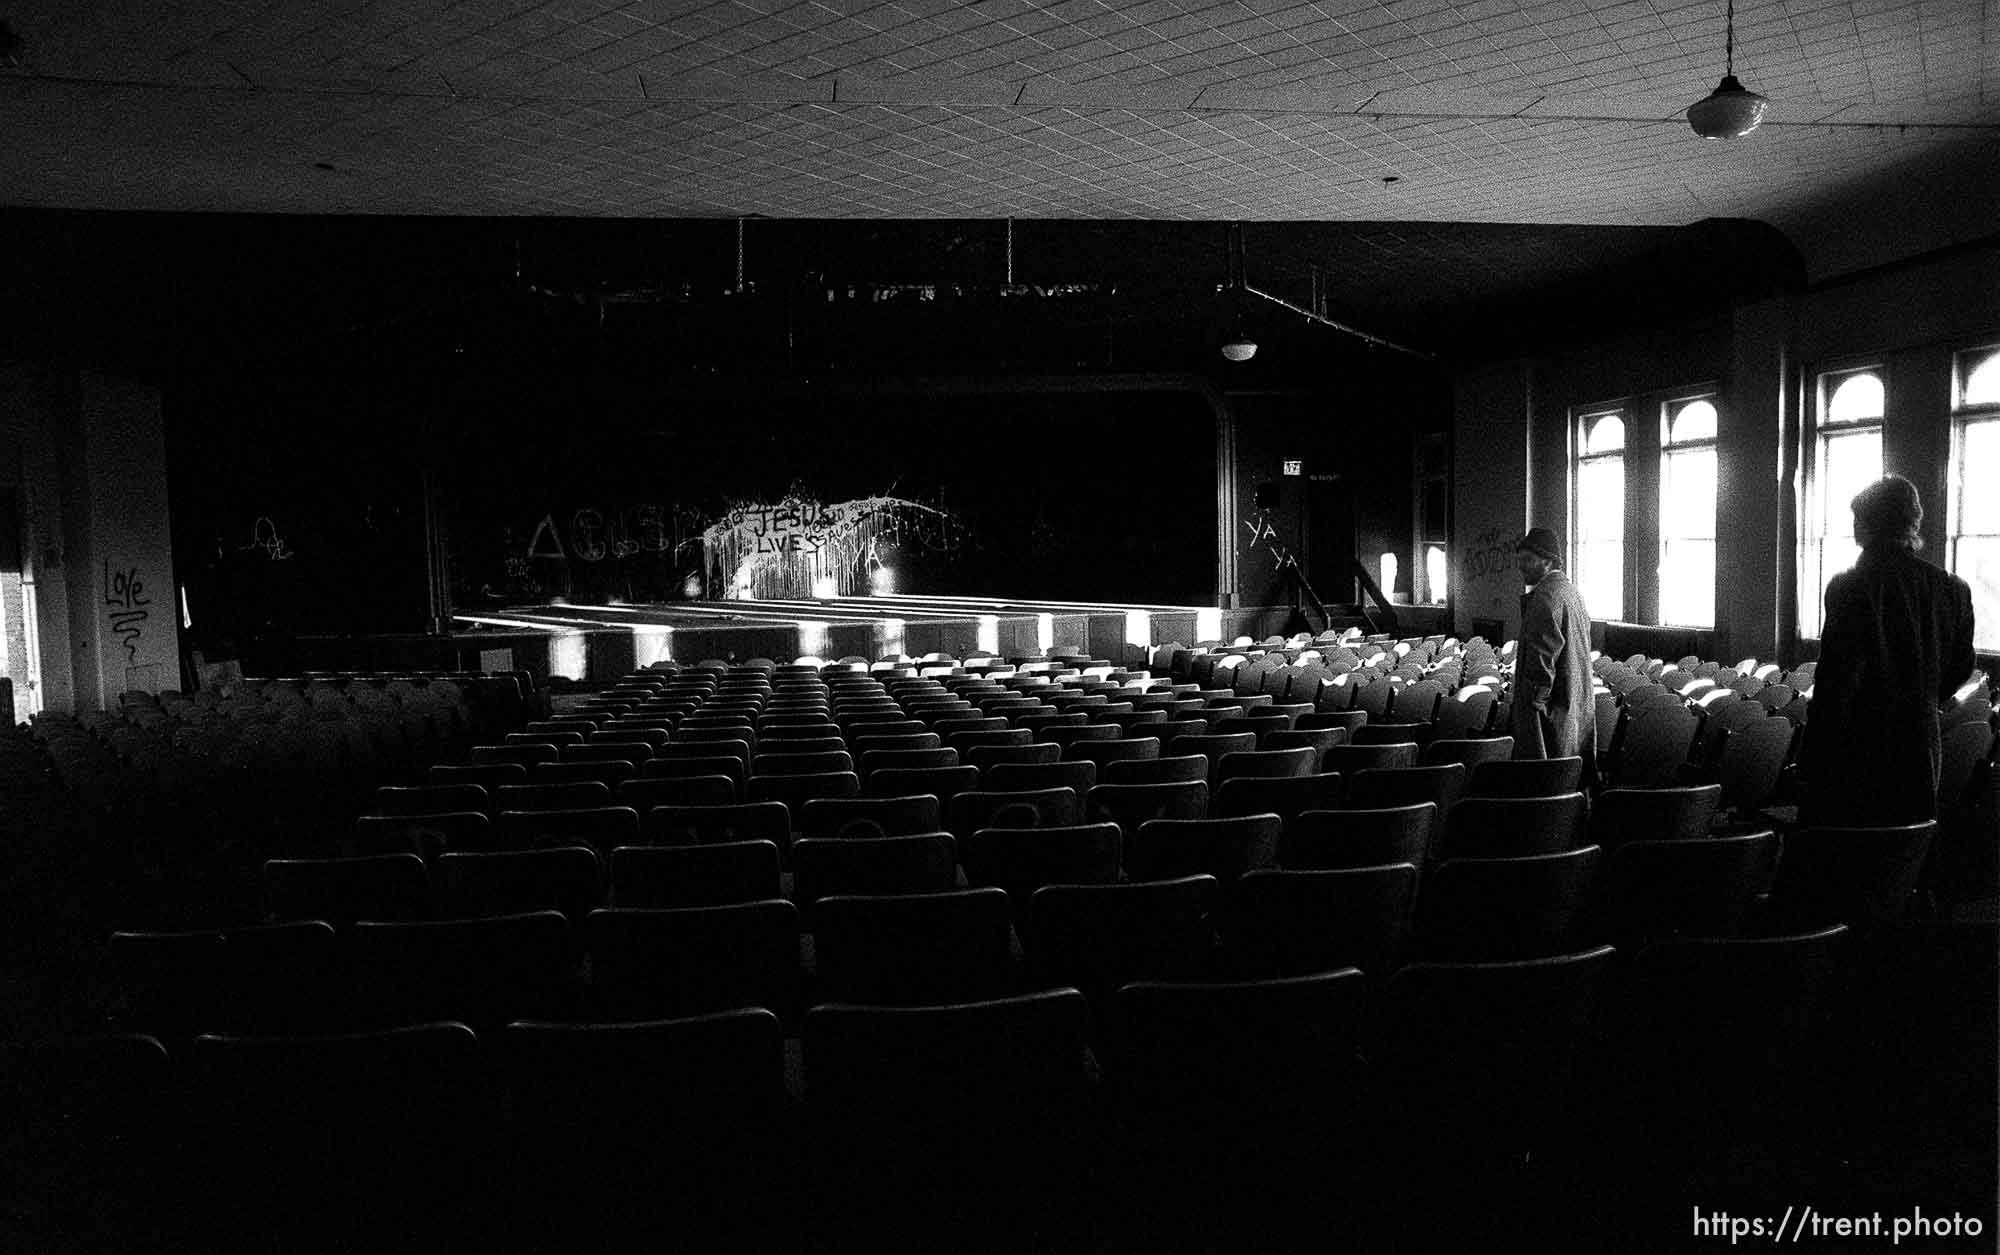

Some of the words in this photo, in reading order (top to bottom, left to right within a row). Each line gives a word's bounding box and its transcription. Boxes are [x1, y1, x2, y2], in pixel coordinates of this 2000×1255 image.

[746, 503, 830, 537] JESUS
[1244, 516, 1277, 548] YA
[1270, 546, 1298, 571] YA
